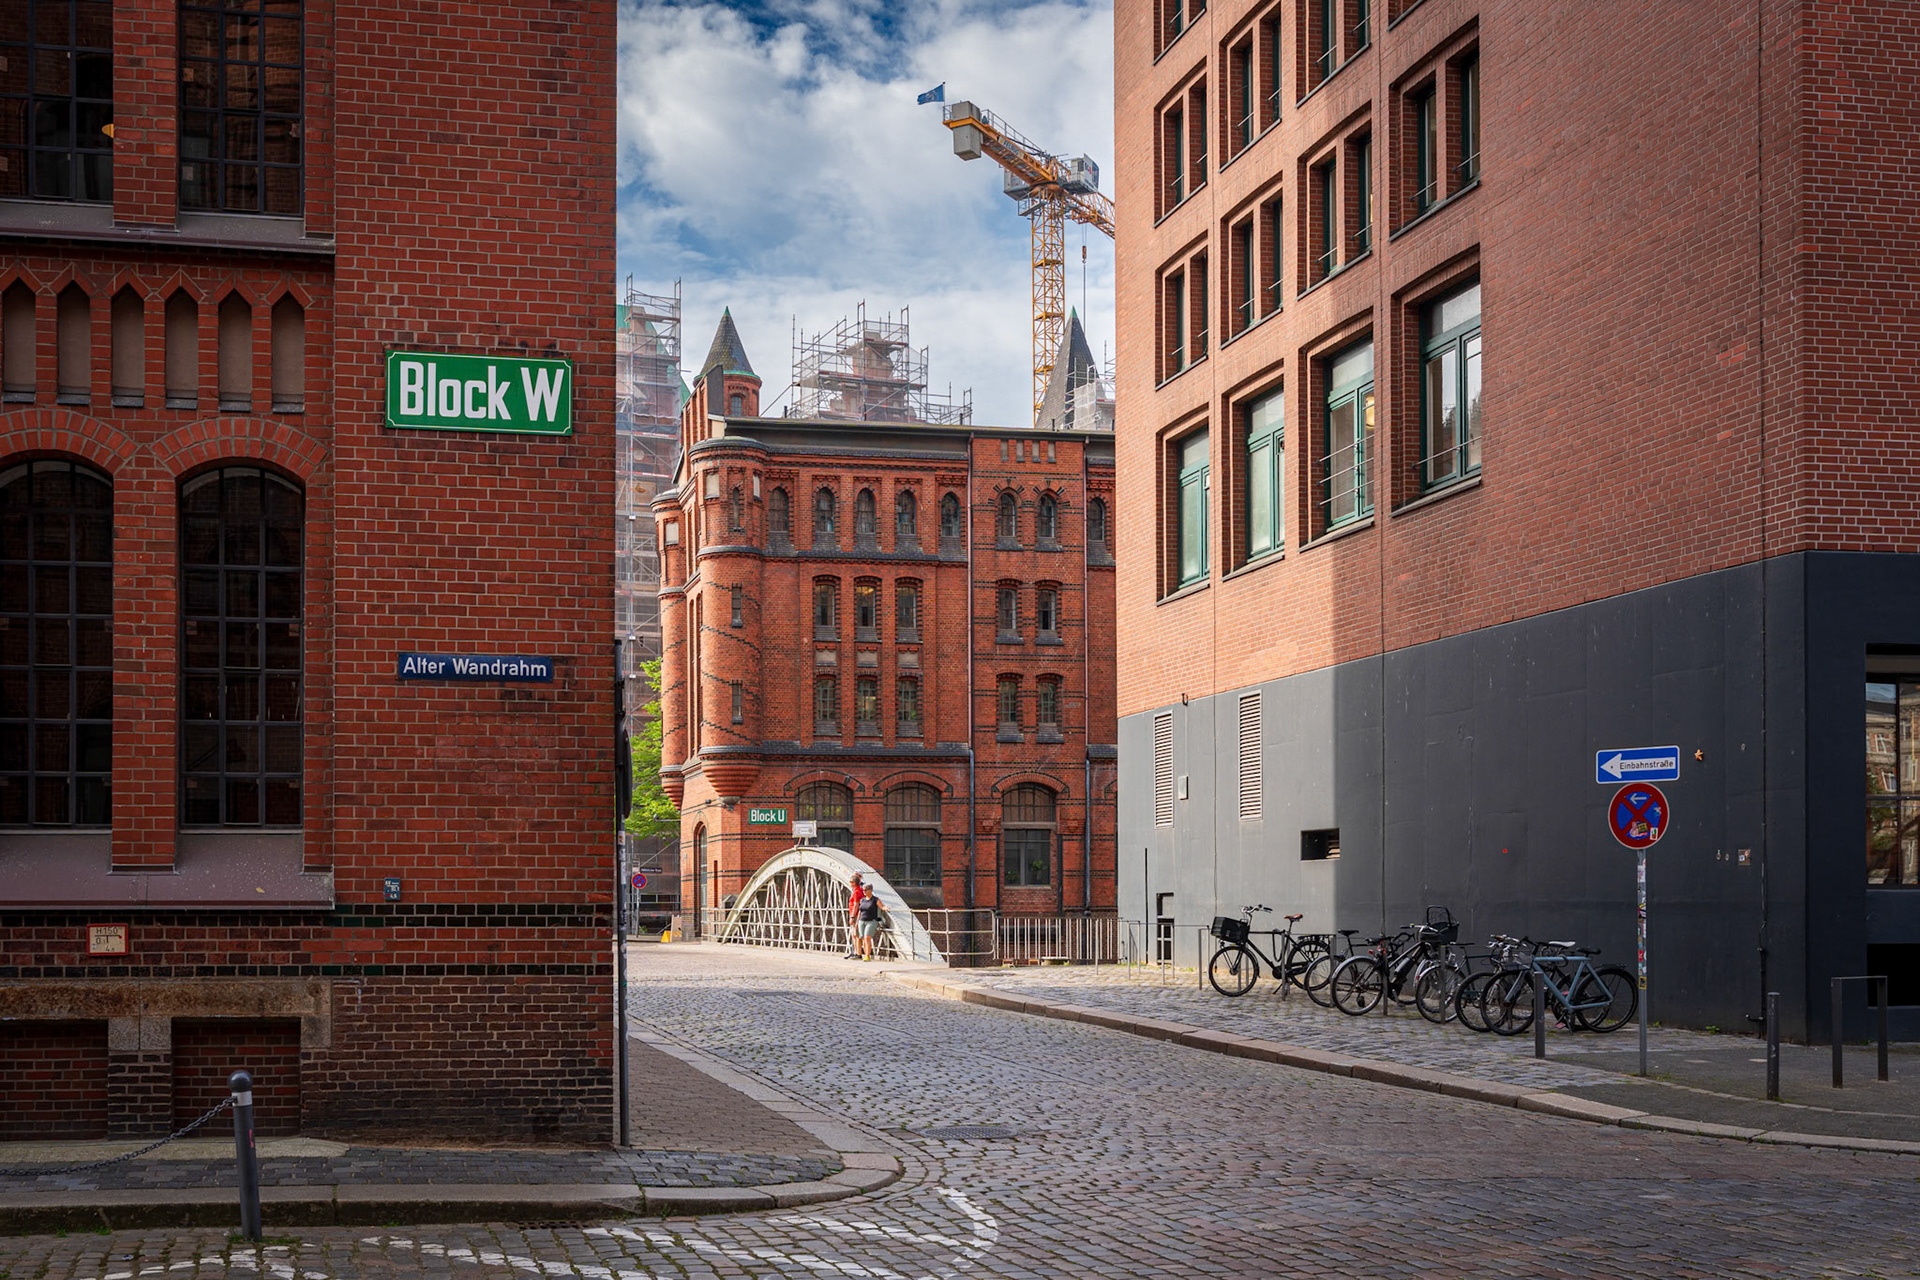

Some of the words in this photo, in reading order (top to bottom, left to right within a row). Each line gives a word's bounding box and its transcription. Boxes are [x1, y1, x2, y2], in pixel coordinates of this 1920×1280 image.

[400, 361, 511, 420] Block
[520, 367, 565, 422] W
[403, 657, 445, 674] Alter
[452, 658, 547, 677] Wandrahm
[1620, 760, 1674, 770] Einbahnstraße
[751, 809, 776, 822] Block
[778, 809, 785, 822] U
